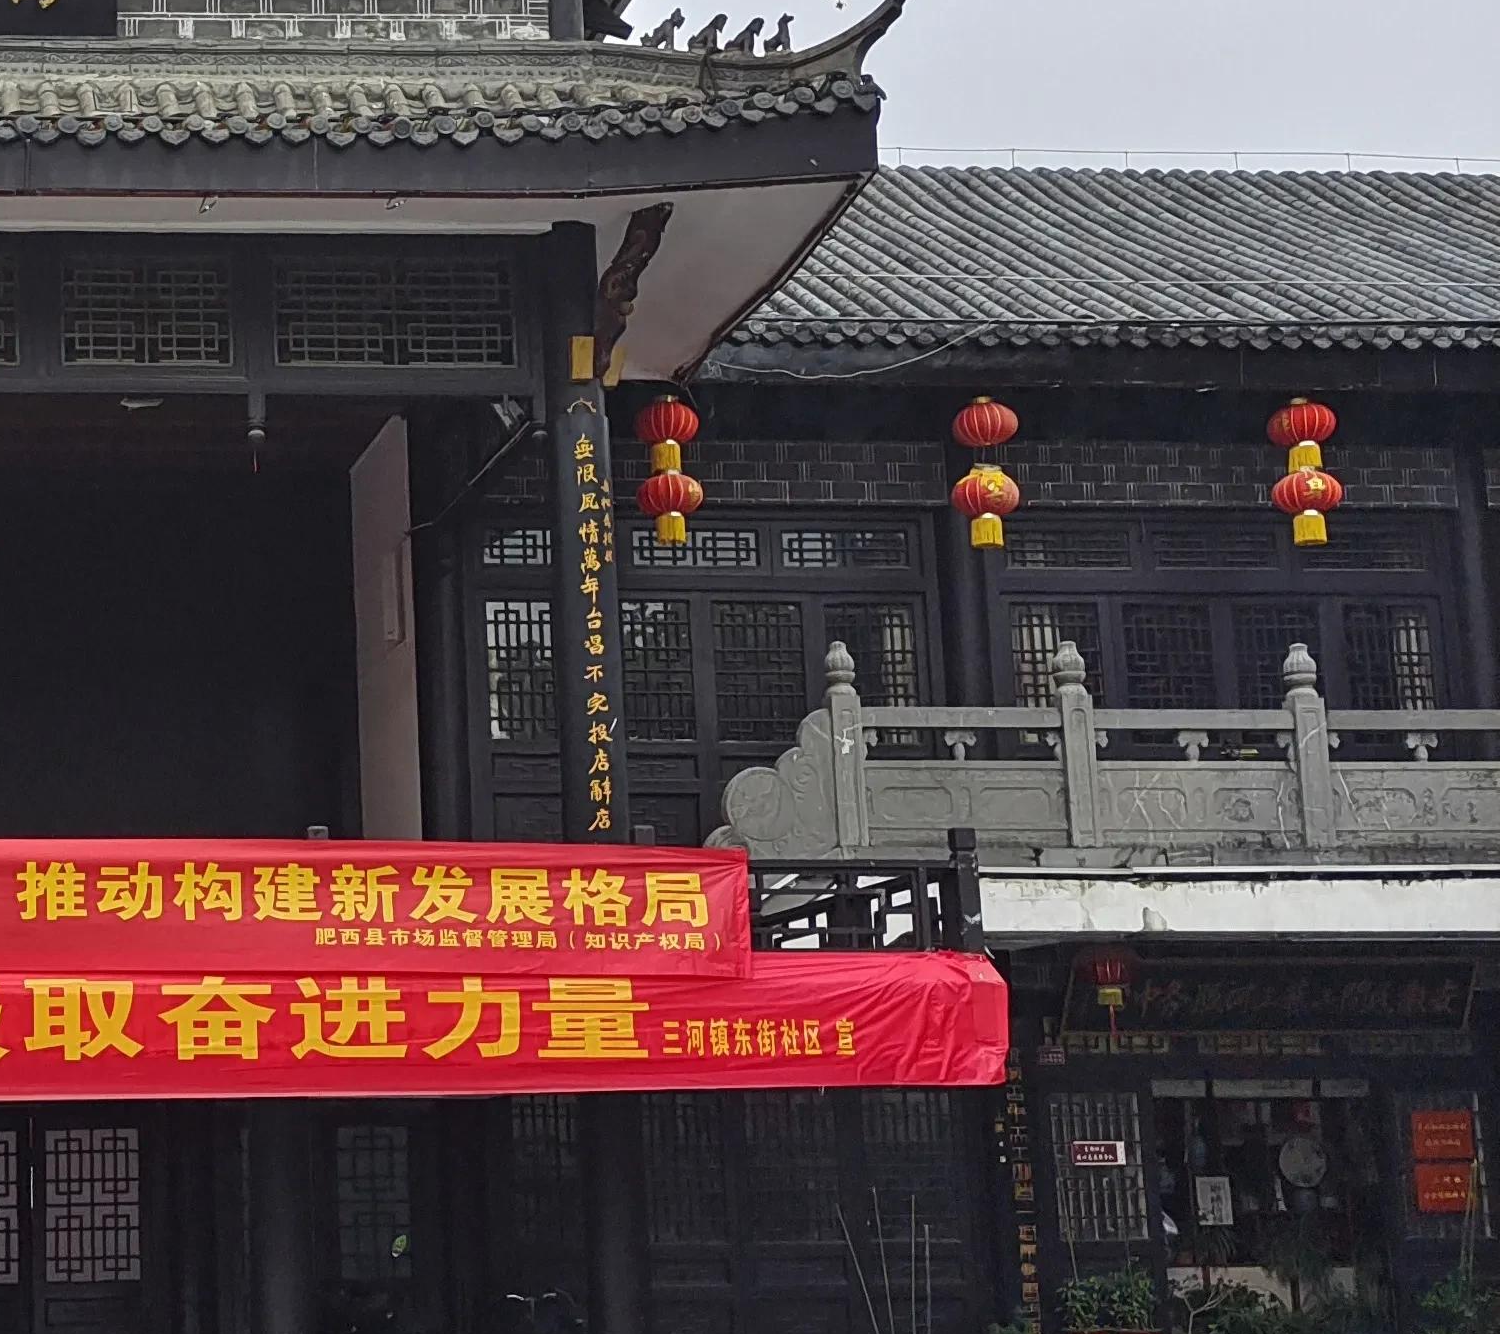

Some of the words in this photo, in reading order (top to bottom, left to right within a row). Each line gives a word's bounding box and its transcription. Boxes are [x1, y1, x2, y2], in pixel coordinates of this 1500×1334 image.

[17, 859, 709, 927] 推动构建新发展格局
[661, 1017, 821, 1058] 三河镇东街社区
[836, 1017, 857, 1058] 宣
